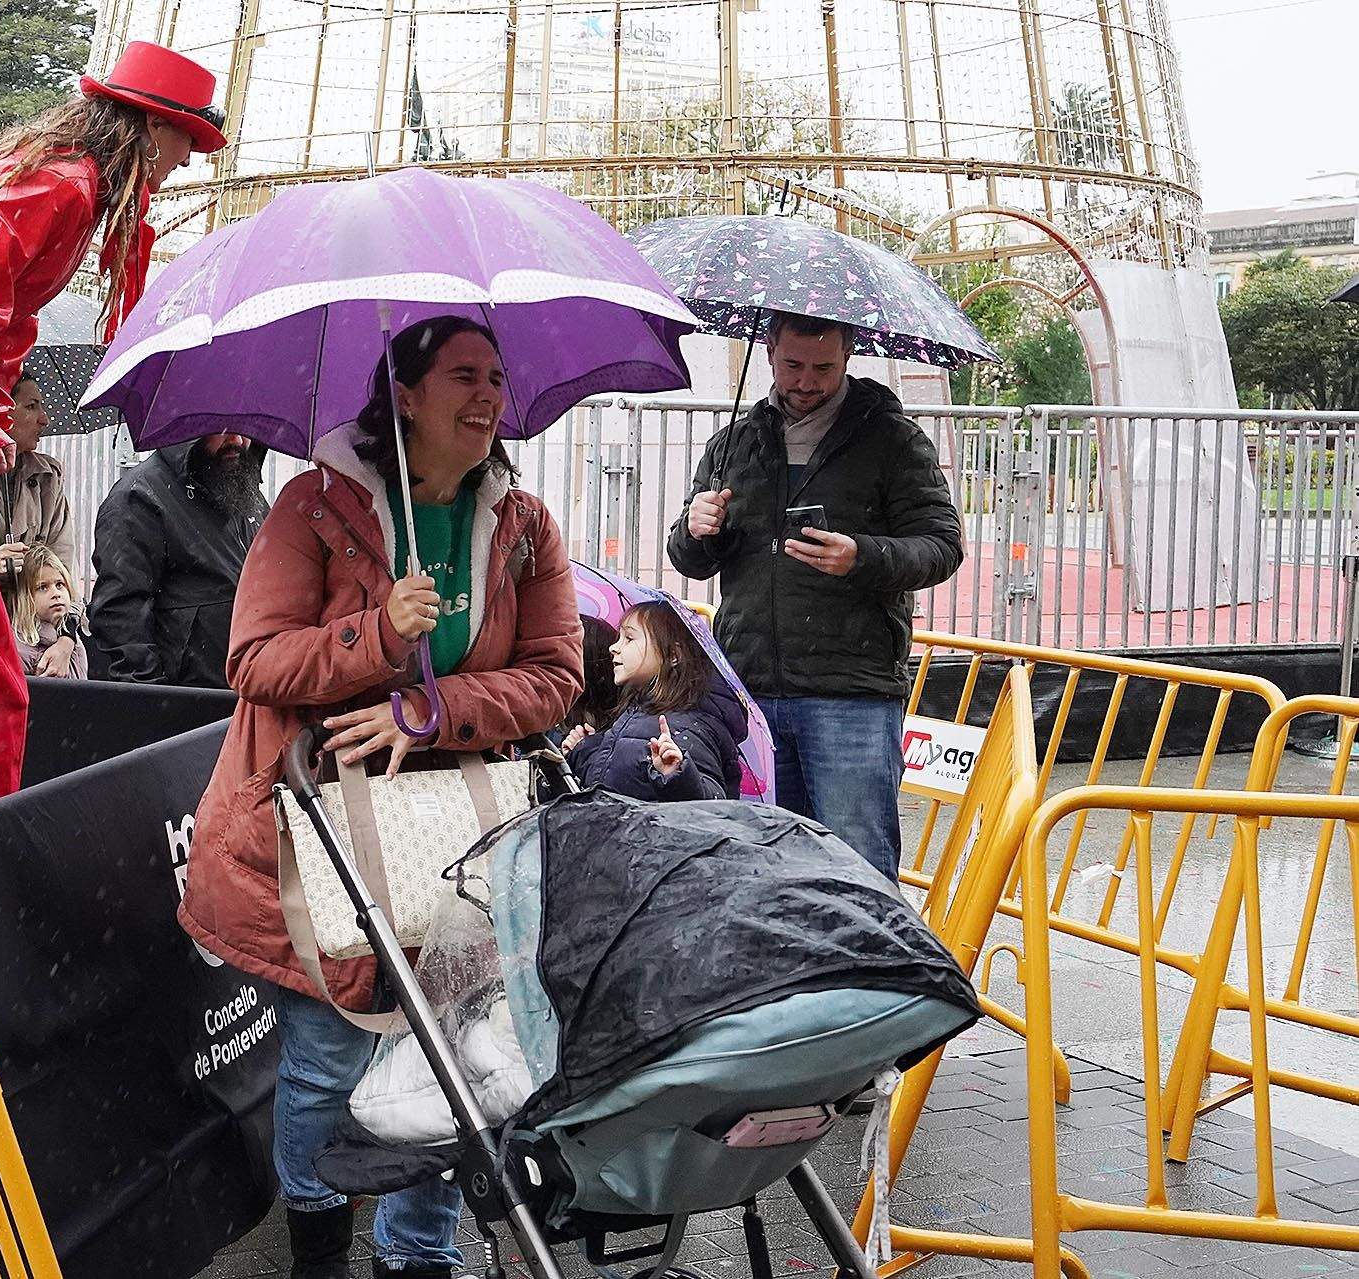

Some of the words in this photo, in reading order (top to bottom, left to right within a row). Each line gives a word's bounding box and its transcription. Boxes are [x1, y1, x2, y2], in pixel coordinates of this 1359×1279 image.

[623, 19, 671, 43] deslas
[204, 984, 258, 1035] Concello
[194, 1052, 211, 1080] de
